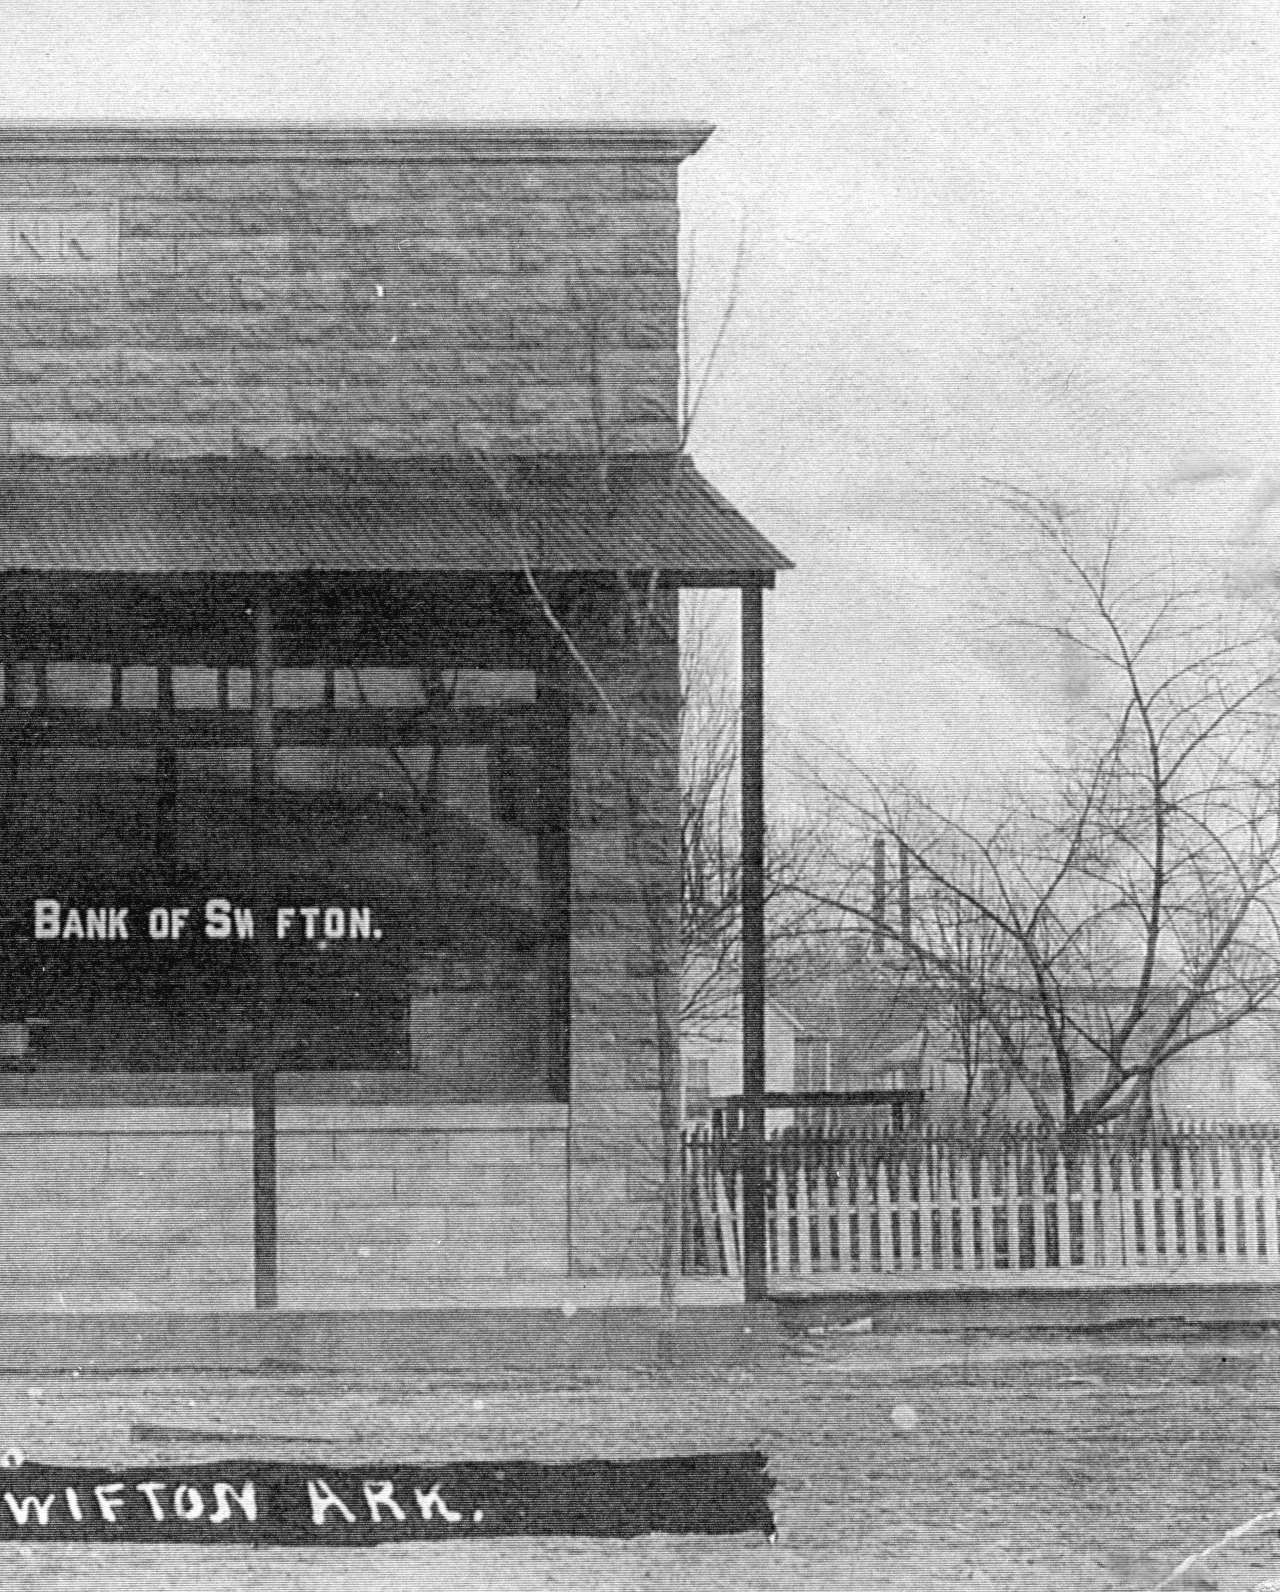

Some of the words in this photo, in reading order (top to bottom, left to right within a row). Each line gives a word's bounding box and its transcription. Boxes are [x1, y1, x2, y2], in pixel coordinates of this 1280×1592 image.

[33, 898, 130, 940] BANK
[148, 906, 190, 940] OF
[204, 897, 384, 940] SWFTON.
